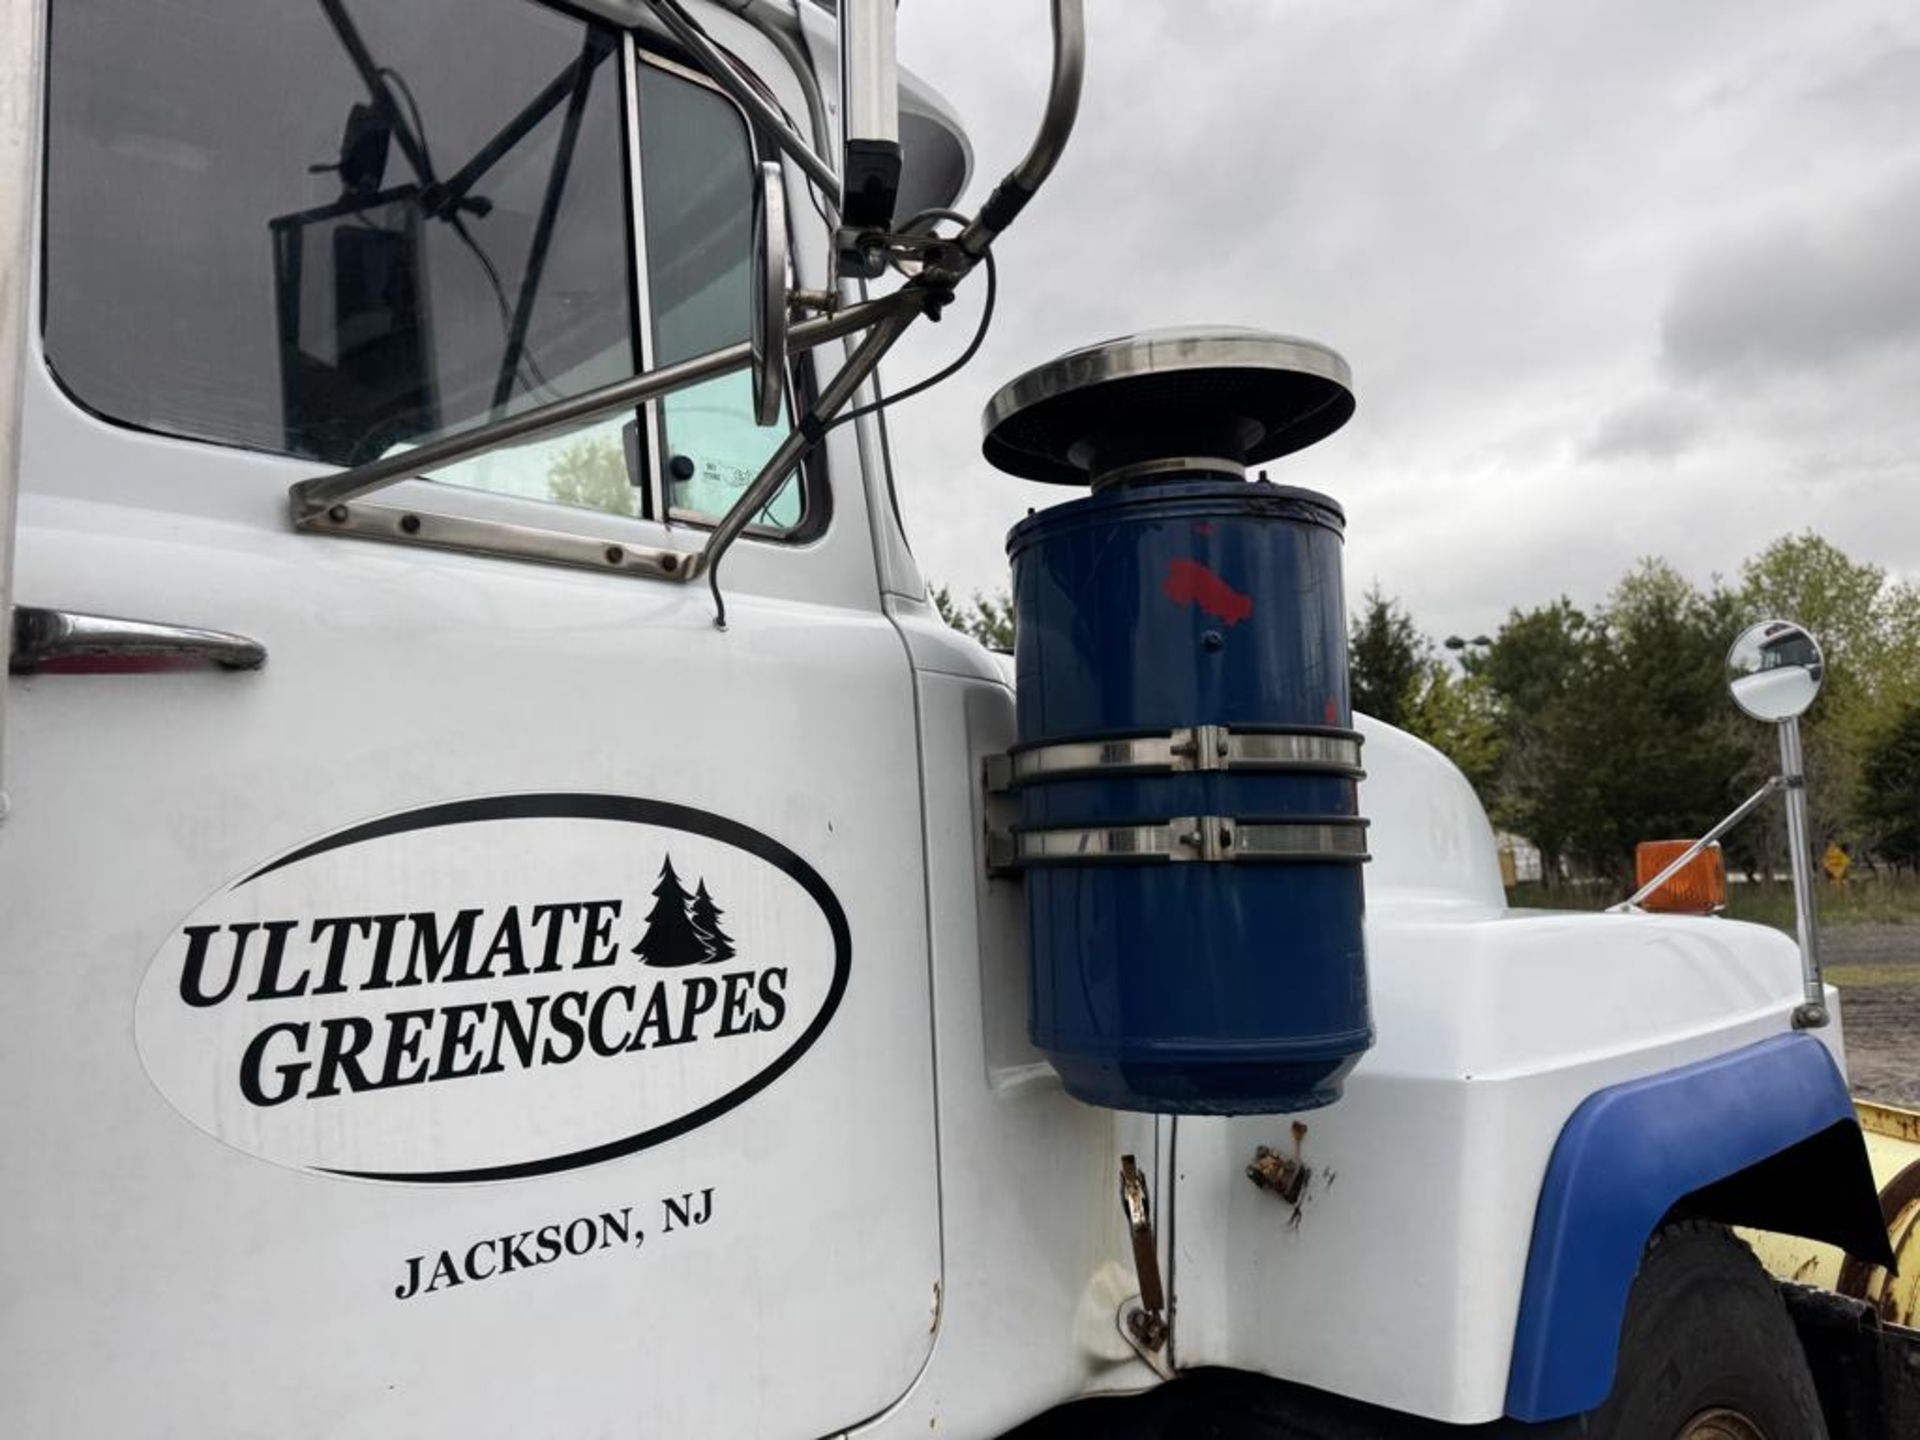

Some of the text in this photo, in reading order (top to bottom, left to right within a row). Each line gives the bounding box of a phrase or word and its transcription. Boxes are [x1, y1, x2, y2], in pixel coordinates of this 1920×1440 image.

[179, 899, 623, 1008] ULTIMATE
[239, 967, 788, 1107] GREENSCAPES
[394, 1188, 717, 1300] JACKSON, NJ
